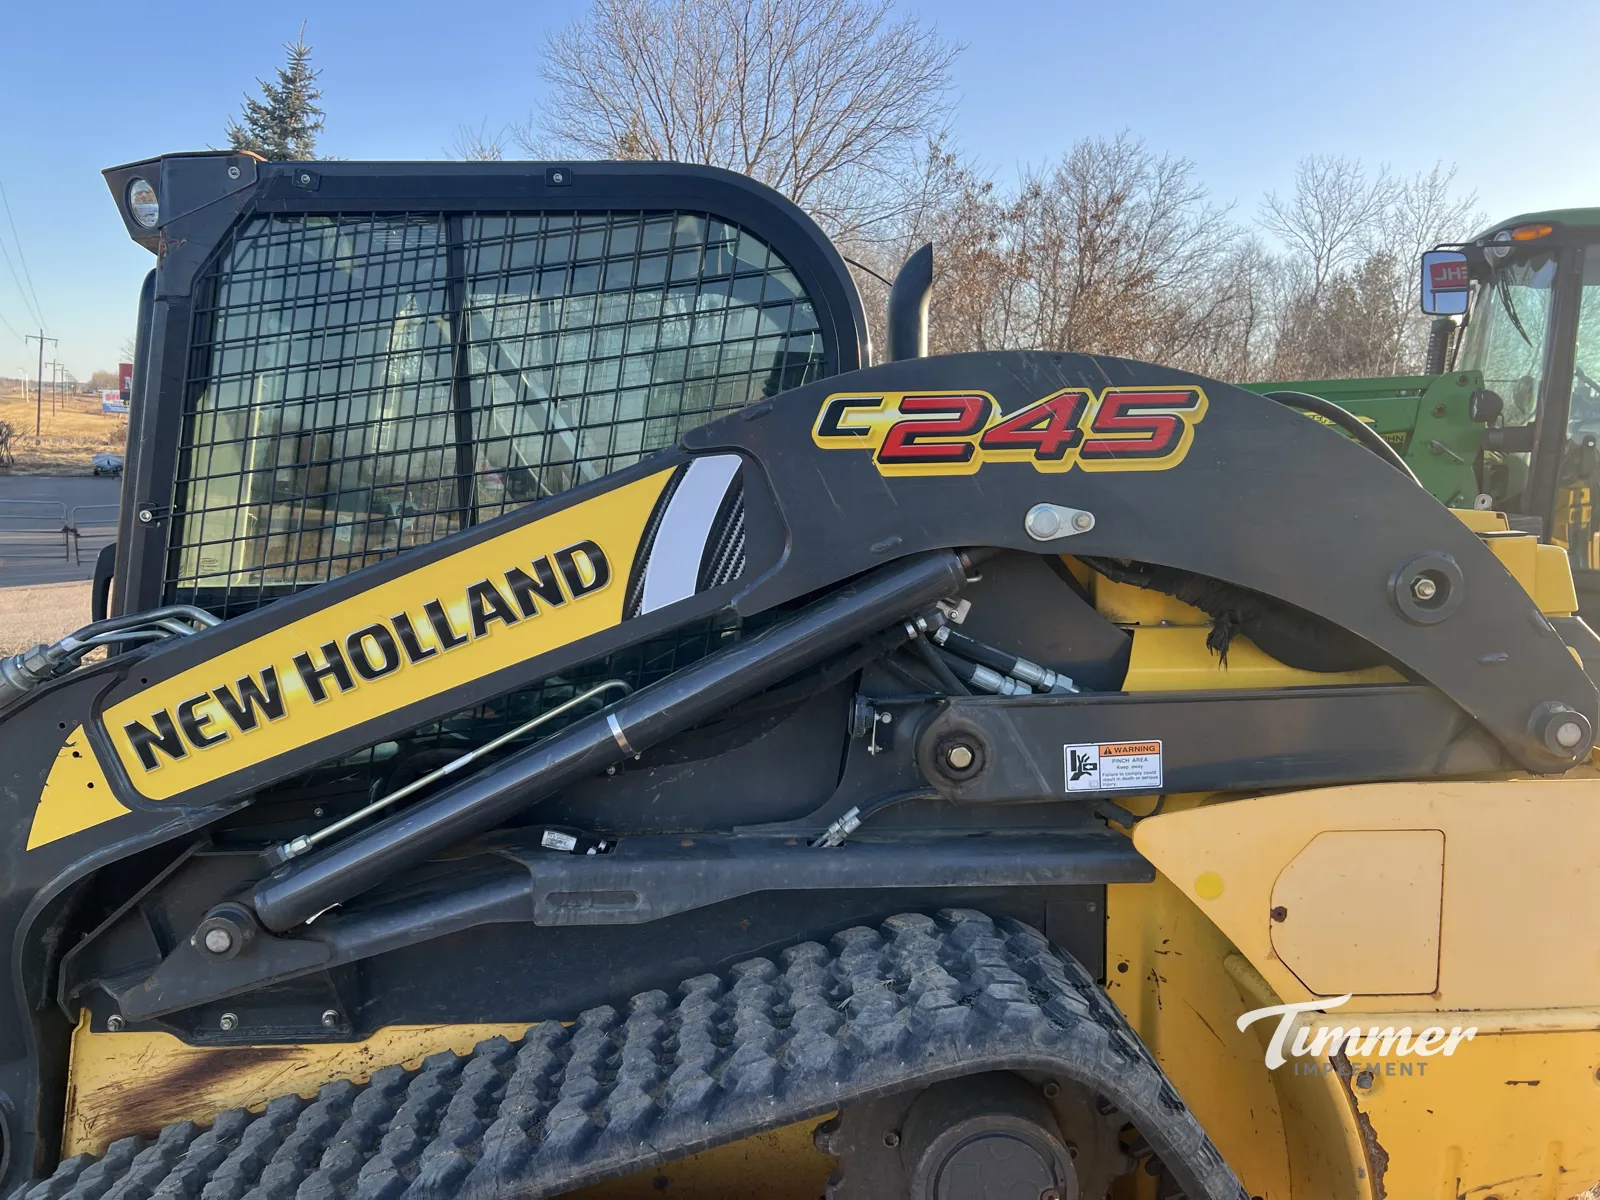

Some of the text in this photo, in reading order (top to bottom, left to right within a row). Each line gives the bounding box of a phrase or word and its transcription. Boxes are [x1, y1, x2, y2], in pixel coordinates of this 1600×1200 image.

[817, 390, 1200, 465] C245
[123, 539, 611, 772] NEW HOLLAND
[1114, 745, 1155, 753] WARNING
